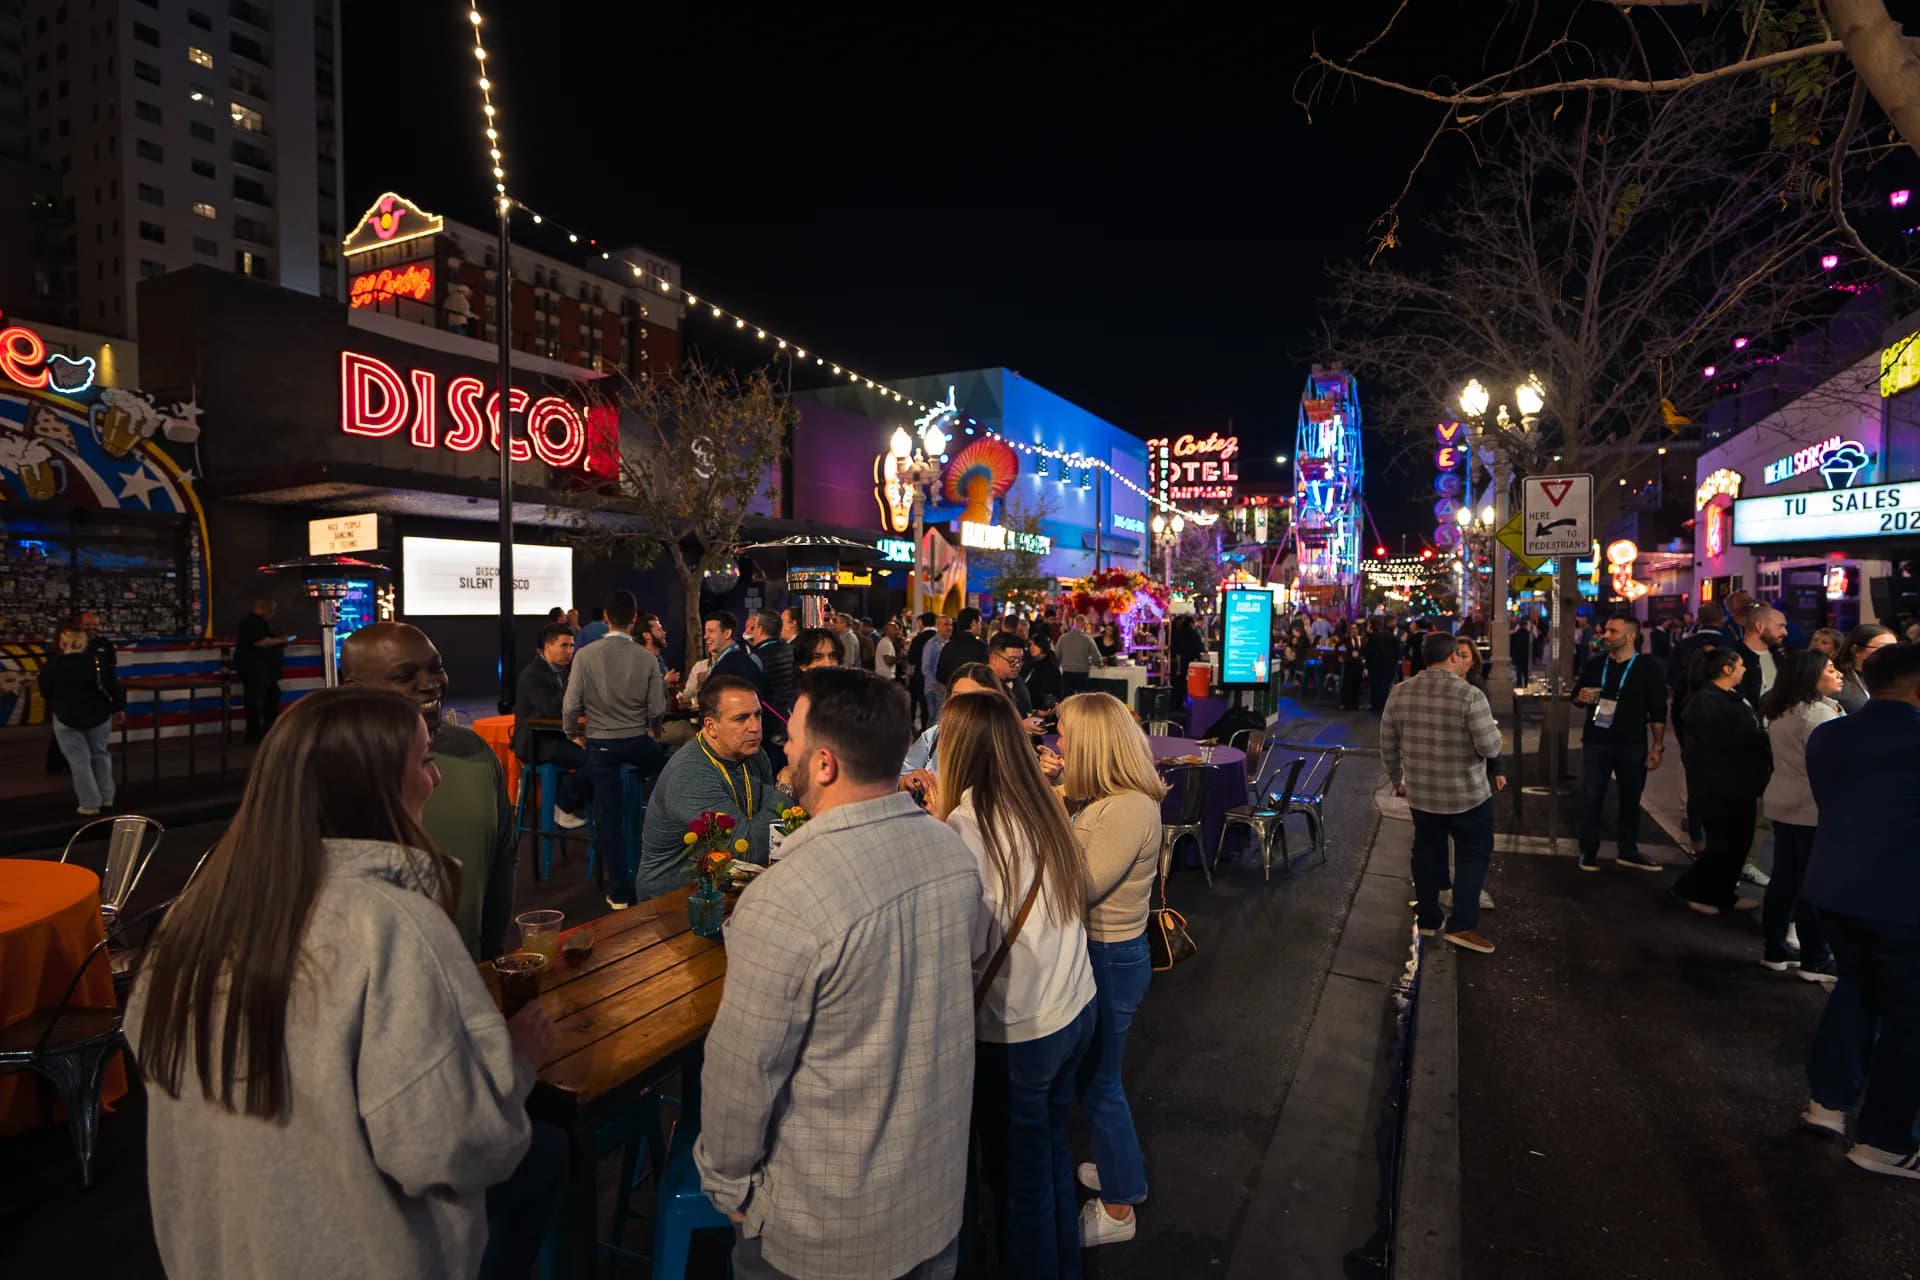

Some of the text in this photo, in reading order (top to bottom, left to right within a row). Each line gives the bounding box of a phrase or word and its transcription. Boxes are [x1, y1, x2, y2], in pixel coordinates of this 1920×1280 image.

[340, 350, 585, 467] DISCO
[1174, 432, 1239, 459] Cortez
[1784, 488, 1901, 516] TU SALES
[1529, 511, 1551, 520] HERE
[1880, 511, 1920, 532] 202
[1567, 529, 1577, 538] TO
[1529, 540, 1586, 551] PEDESTRIANS
[459, 577, 493, 589] SILENT
